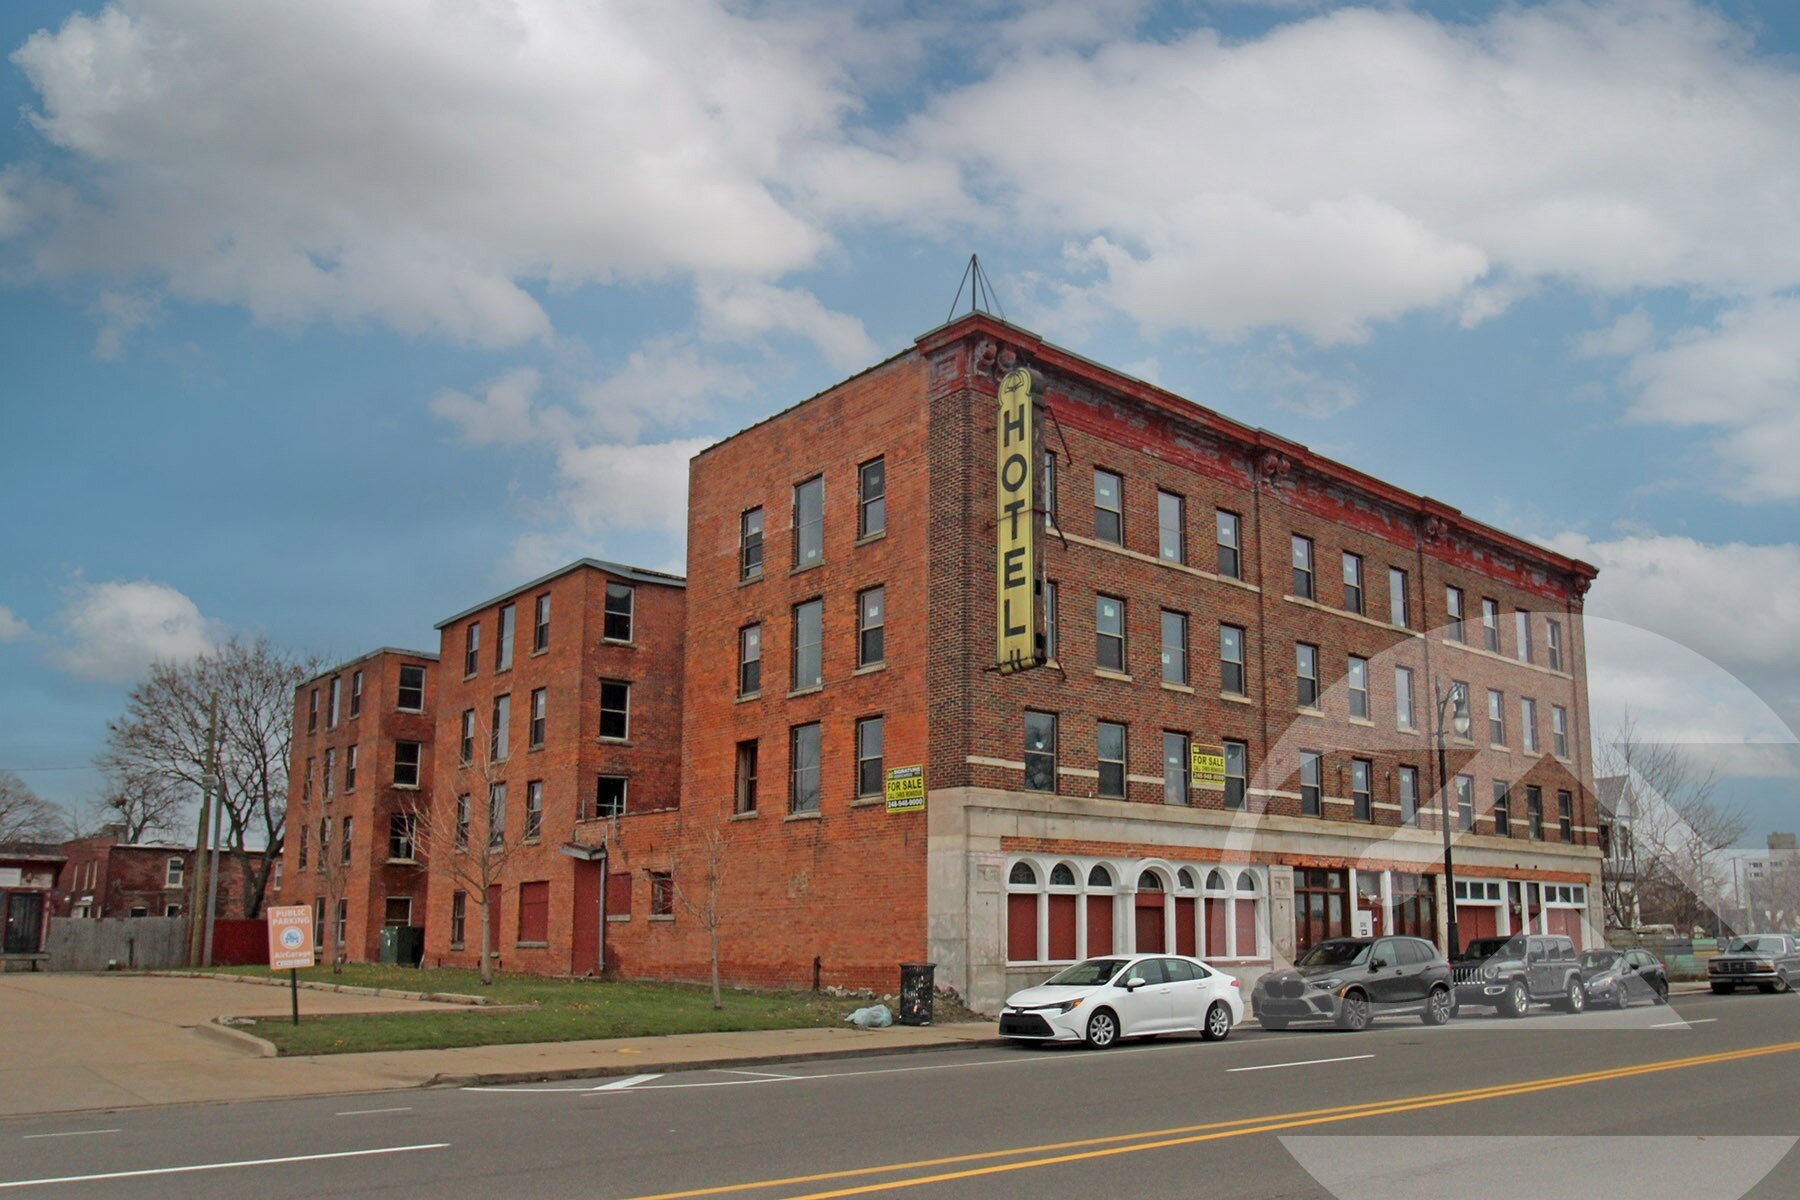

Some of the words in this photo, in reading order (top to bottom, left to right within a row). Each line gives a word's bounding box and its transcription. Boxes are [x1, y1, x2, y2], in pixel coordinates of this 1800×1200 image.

[1001, 403, 1027, 637] HOTEL
[1193, 755, 1207, 765] FOR
[1209, 757, 1224, 767] SALE
[888, 781, 901, 792] FOR
[902, 779, 922, 790] SALE
[272, 916, 310, 925] PARKING
